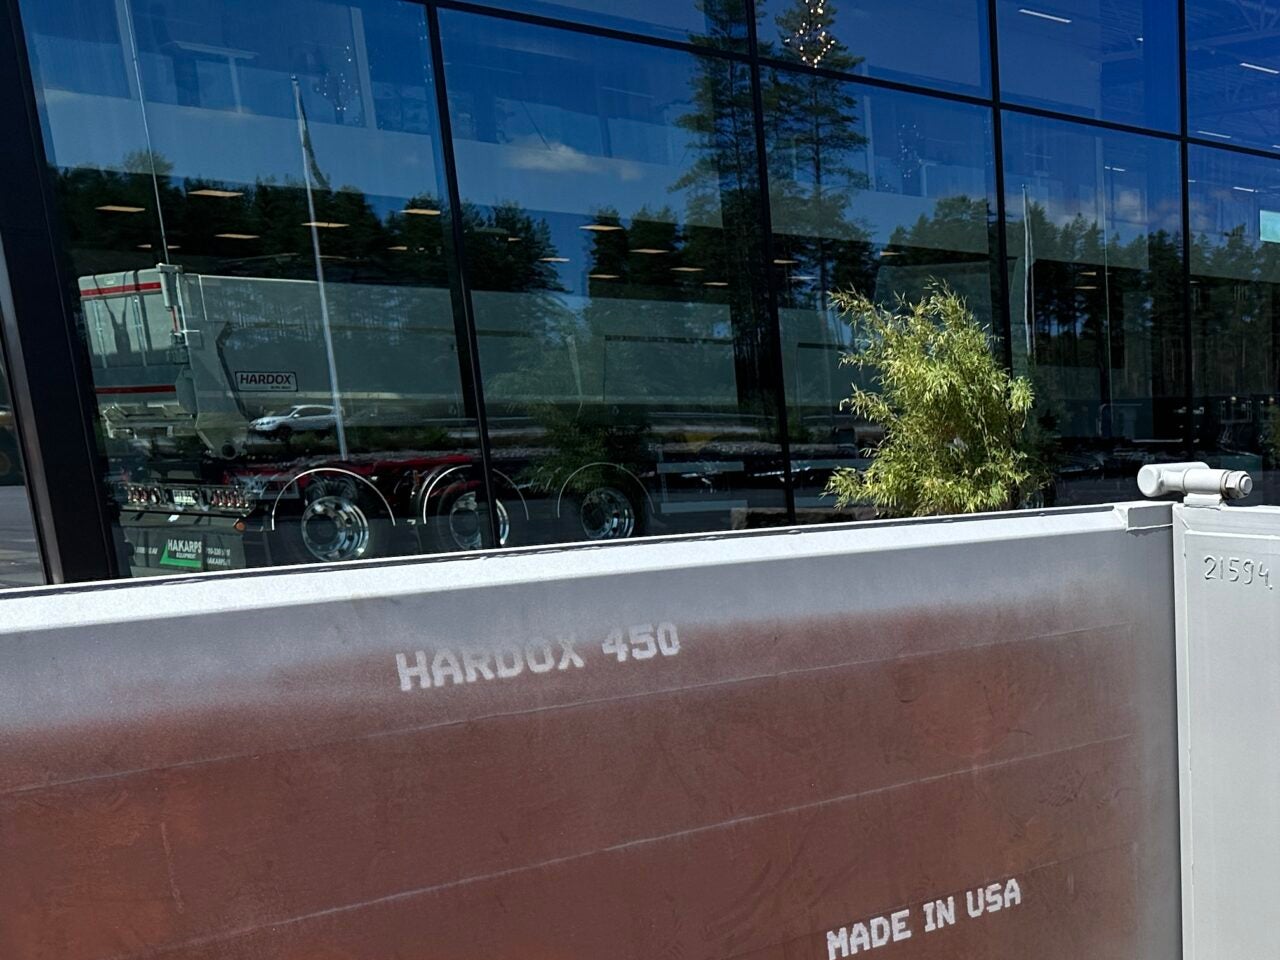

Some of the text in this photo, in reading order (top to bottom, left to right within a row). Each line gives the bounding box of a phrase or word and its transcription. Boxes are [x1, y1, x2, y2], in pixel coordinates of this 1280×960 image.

[240, 374, 292, 385] HARDOX
[167, 538, 202, 553] HAKARPS
[396, 622, 681, 692] HARDOX 450
[826, 878, 1022, 960] MADE IN USA
